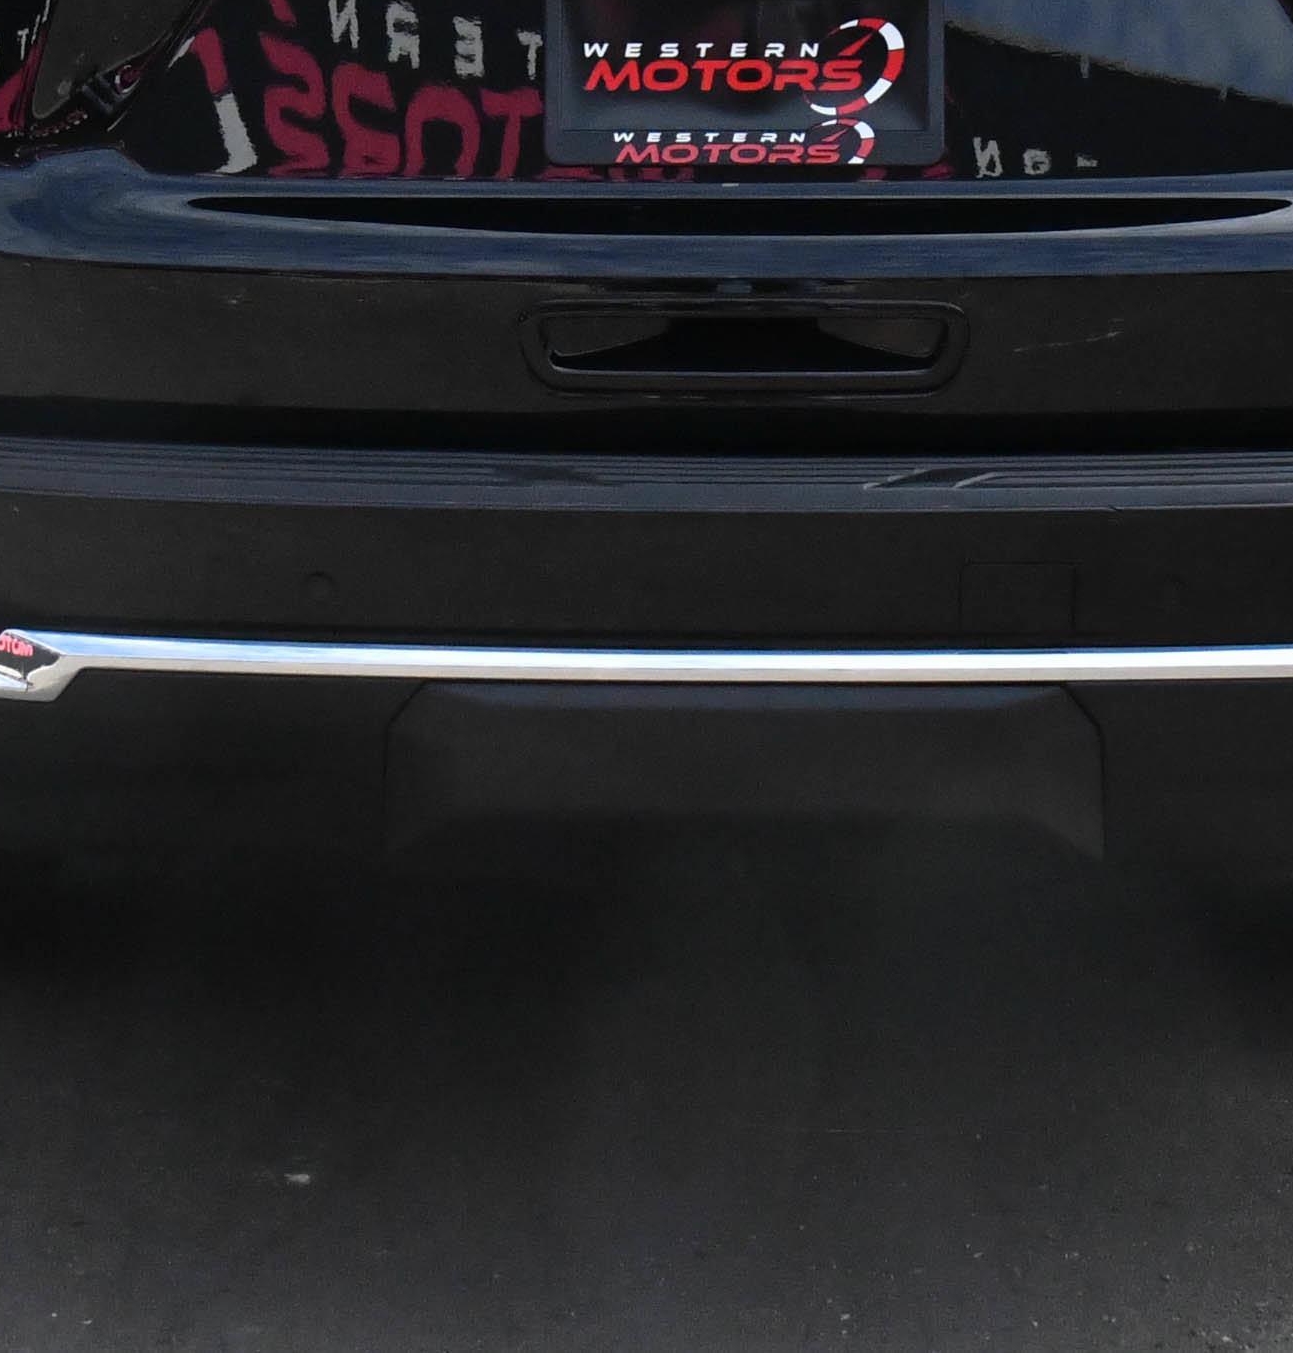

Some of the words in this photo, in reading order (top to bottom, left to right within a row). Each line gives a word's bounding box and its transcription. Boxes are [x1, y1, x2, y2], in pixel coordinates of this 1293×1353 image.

[583, 41, 820, 58] WESTERN
[583, 58, 863, 92] MOTORS
[613, 132, 806, 143] WESTERN
[614, 143, 841, 164] MOTORS
